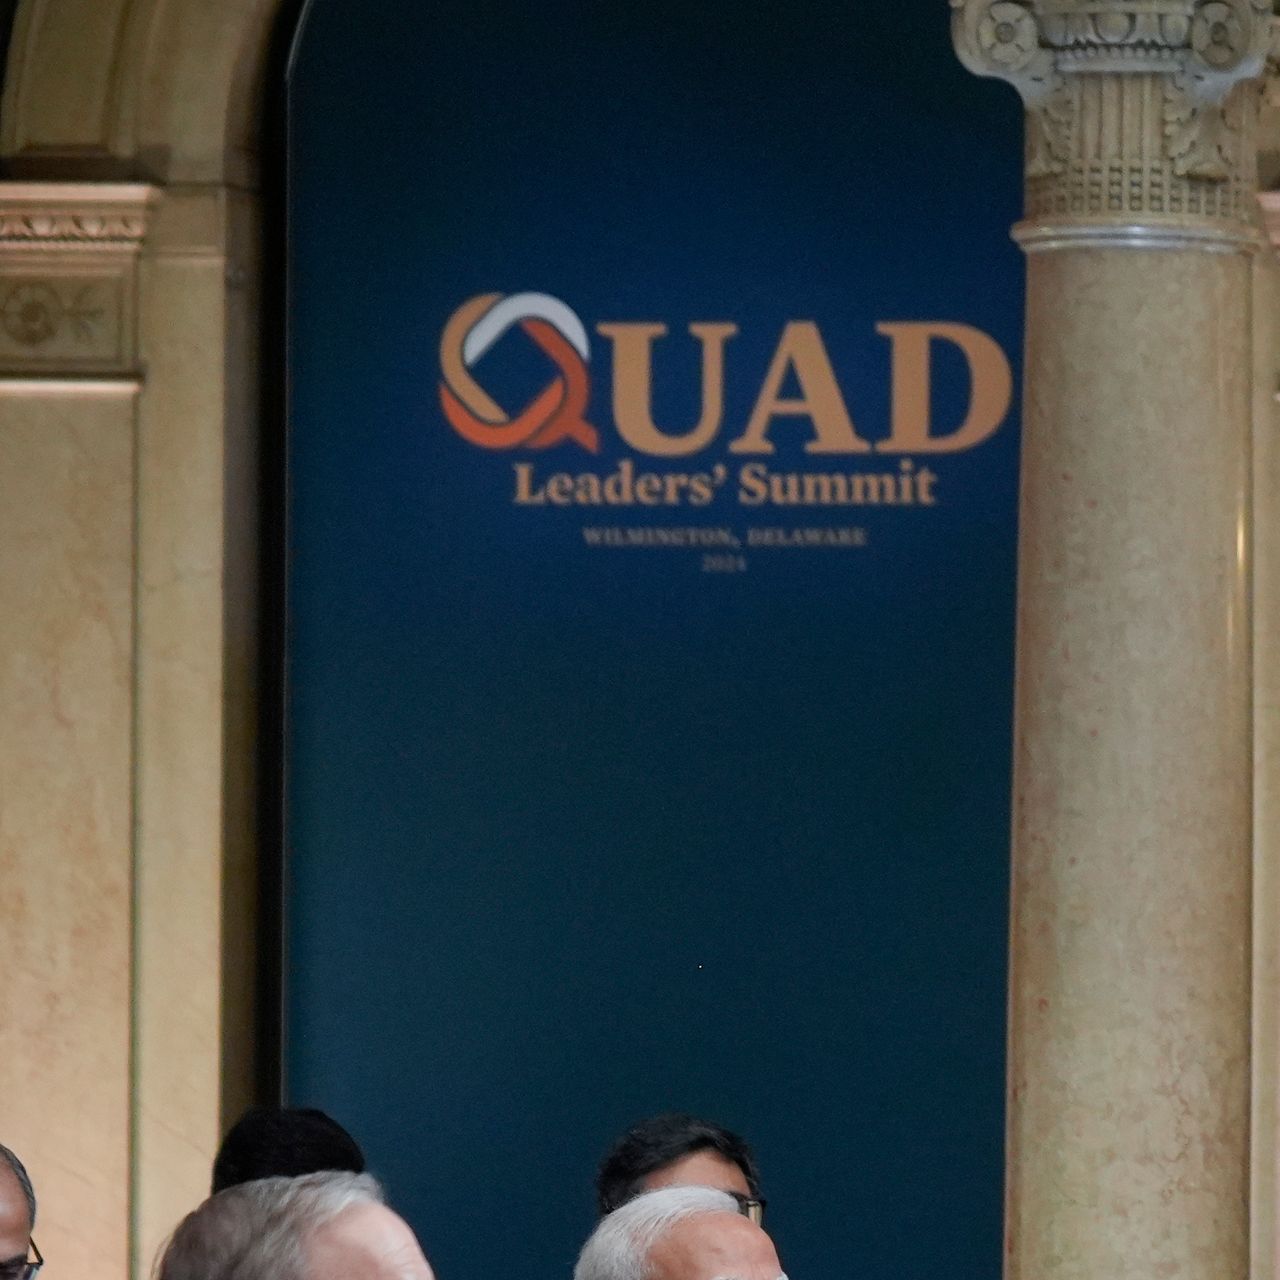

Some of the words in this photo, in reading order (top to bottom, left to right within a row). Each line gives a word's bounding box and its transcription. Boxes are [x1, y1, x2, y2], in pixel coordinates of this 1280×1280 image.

[439, 292, 1013, 457] QUAD
[512, 459, 727, 505] Leaders’
[738, 459, 938, 505] Summit
[582, 527, 742, 550] WILMINGTON,
[747, 527, 868, 547] DELAWARE
